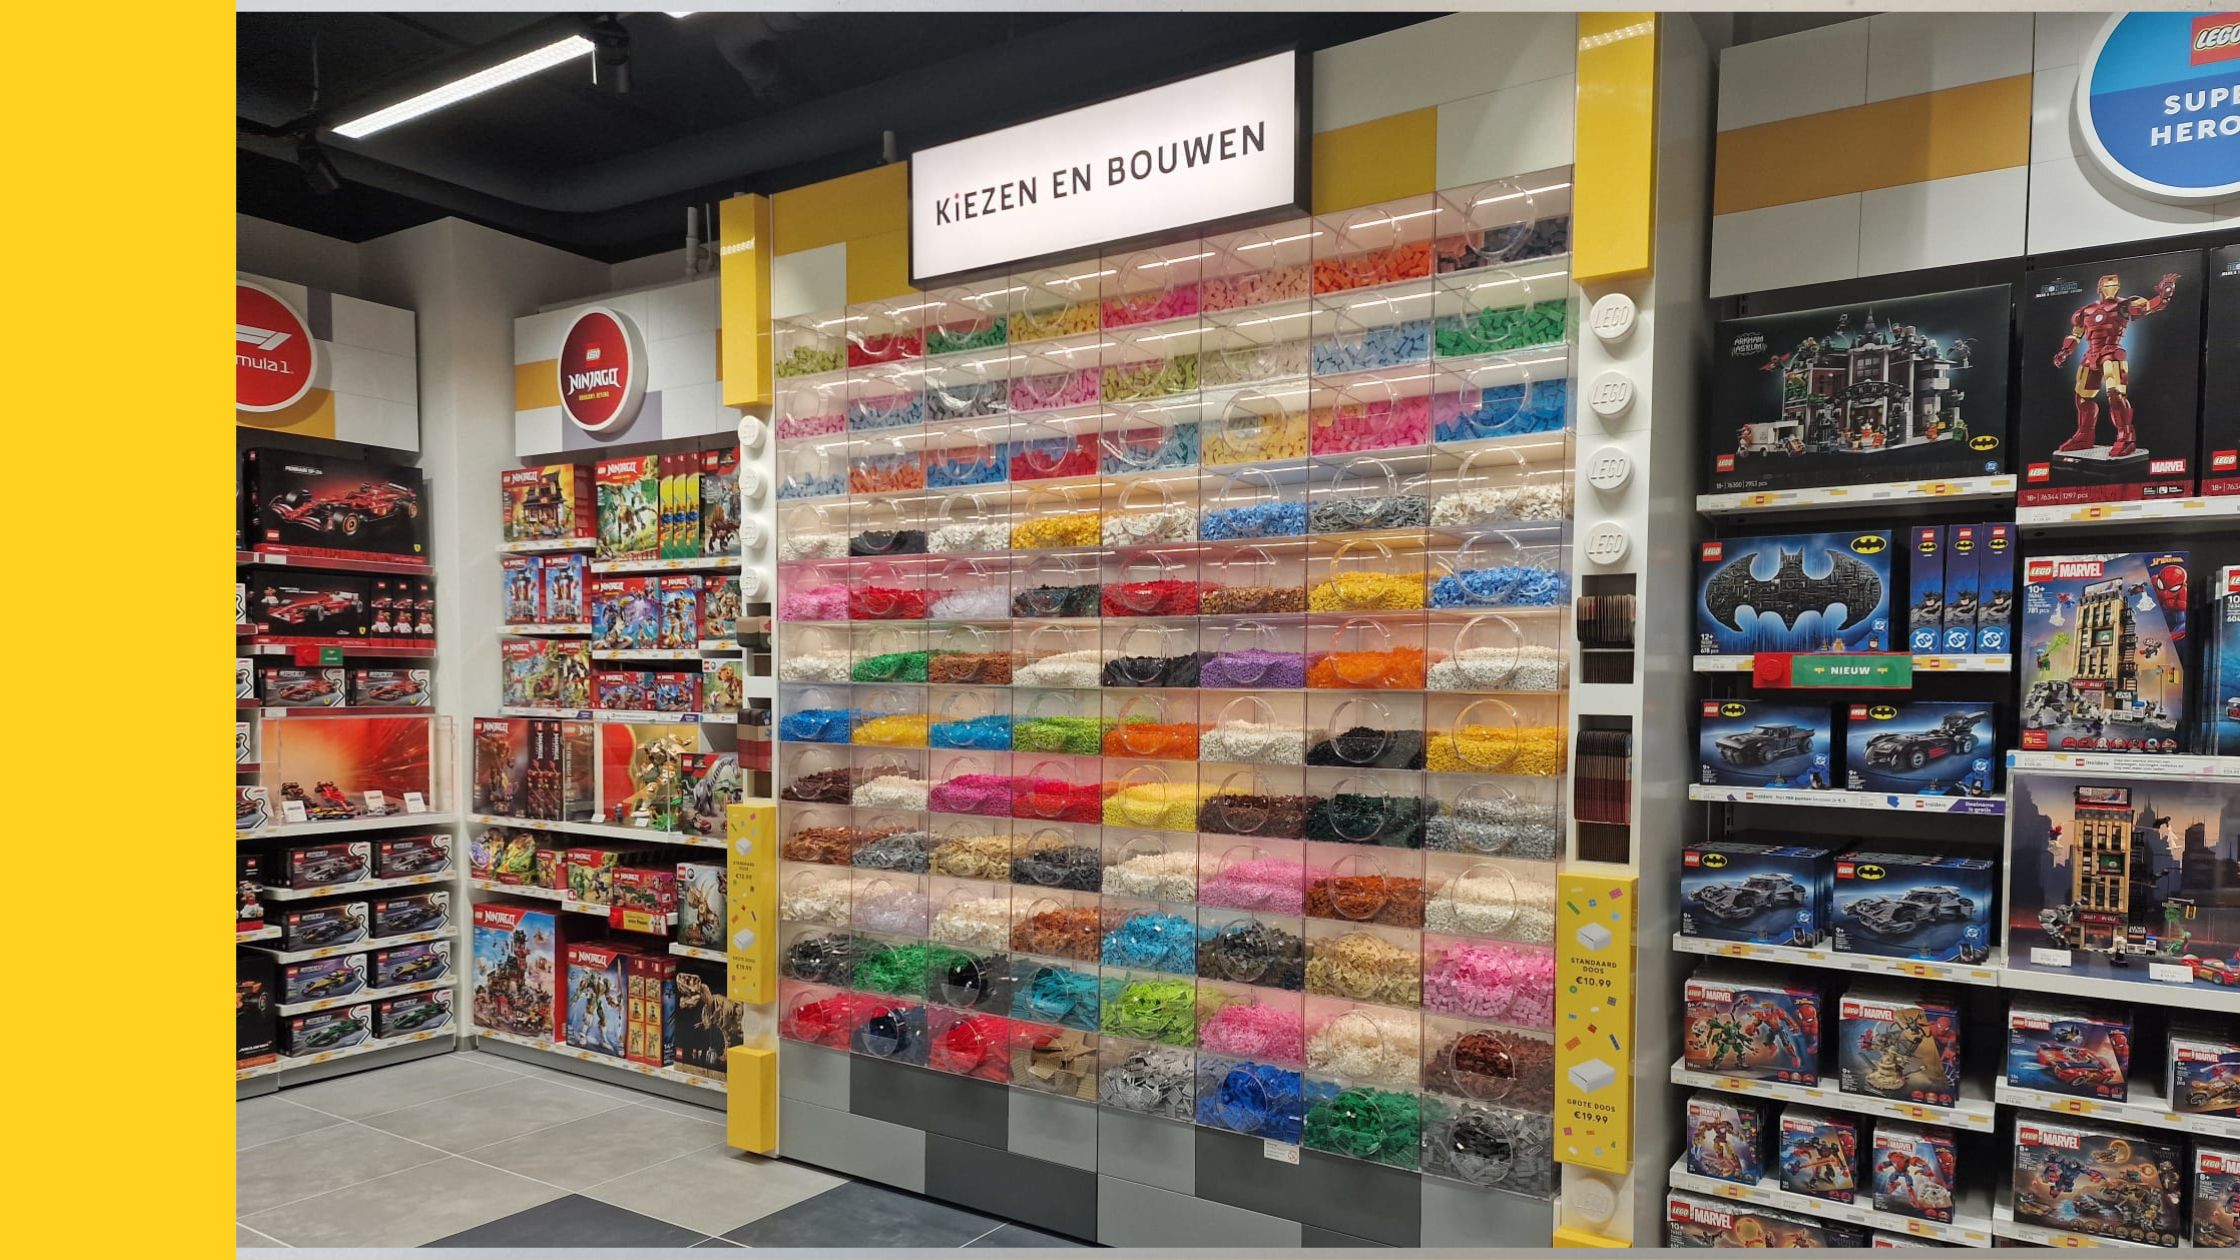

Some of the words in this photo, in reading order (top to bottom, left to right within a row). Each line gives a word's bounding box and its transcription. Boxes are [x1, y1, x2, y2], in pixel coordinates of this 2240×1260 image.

[2194, 23, 2240, 51] LEGO
[2151, 115, 2240, 147] HERO
[1053, 163, 1092, 199] EN
[1108, 121, 1265, 186] BOUWEN
[1594, 306, 1629, 329] LEGO
[568, 367, 621, 396] NINJAGO
[1592, 382, 1627, 404] LEGO
[2151, 461, 2185, 473] MARVEL
[2215, 455, 2237, 466] LEGO
[1590, 459, 1625, 480] LEGO
[2029, 467, 2049, 477] LEGO
[1588, 534, 1623, 554] LEGO
[2031, 567, 2051, 576] LEGO
[2060, 563, 2102, 578] MARVEL
[1700, 633, 1714, 641] 12+
[1917, 634, 1932, 646] DC
[1950, 633, 1965, 646] DC
[1985, 633, 2000, 645] DC
[1830, 665, 1870, 676] NIEUW
[1571, 957, 1617, 968] STANDAARD
[1583, 966, 1605, 974] DOOS
[1576, 976, 1611, 988] €10.99
[1706, 989, 1732, 1002] MARVEL
[1864, 1008, 1892, 1020] MARVEL
[1567, 1099, 1592, 1109] GROTE
[1594, 1101, 1616, 1112] DOOS
[1574, 1111, 1608, 1124] €19.99
[2043, 1133, 2079, 1150] MARVEL
[1672, 1206, 1689, 1216] LEGO
[1694, 1208, 1732, 1229] MARVEL
[1670, 1222, 1684, 1230] 10+
